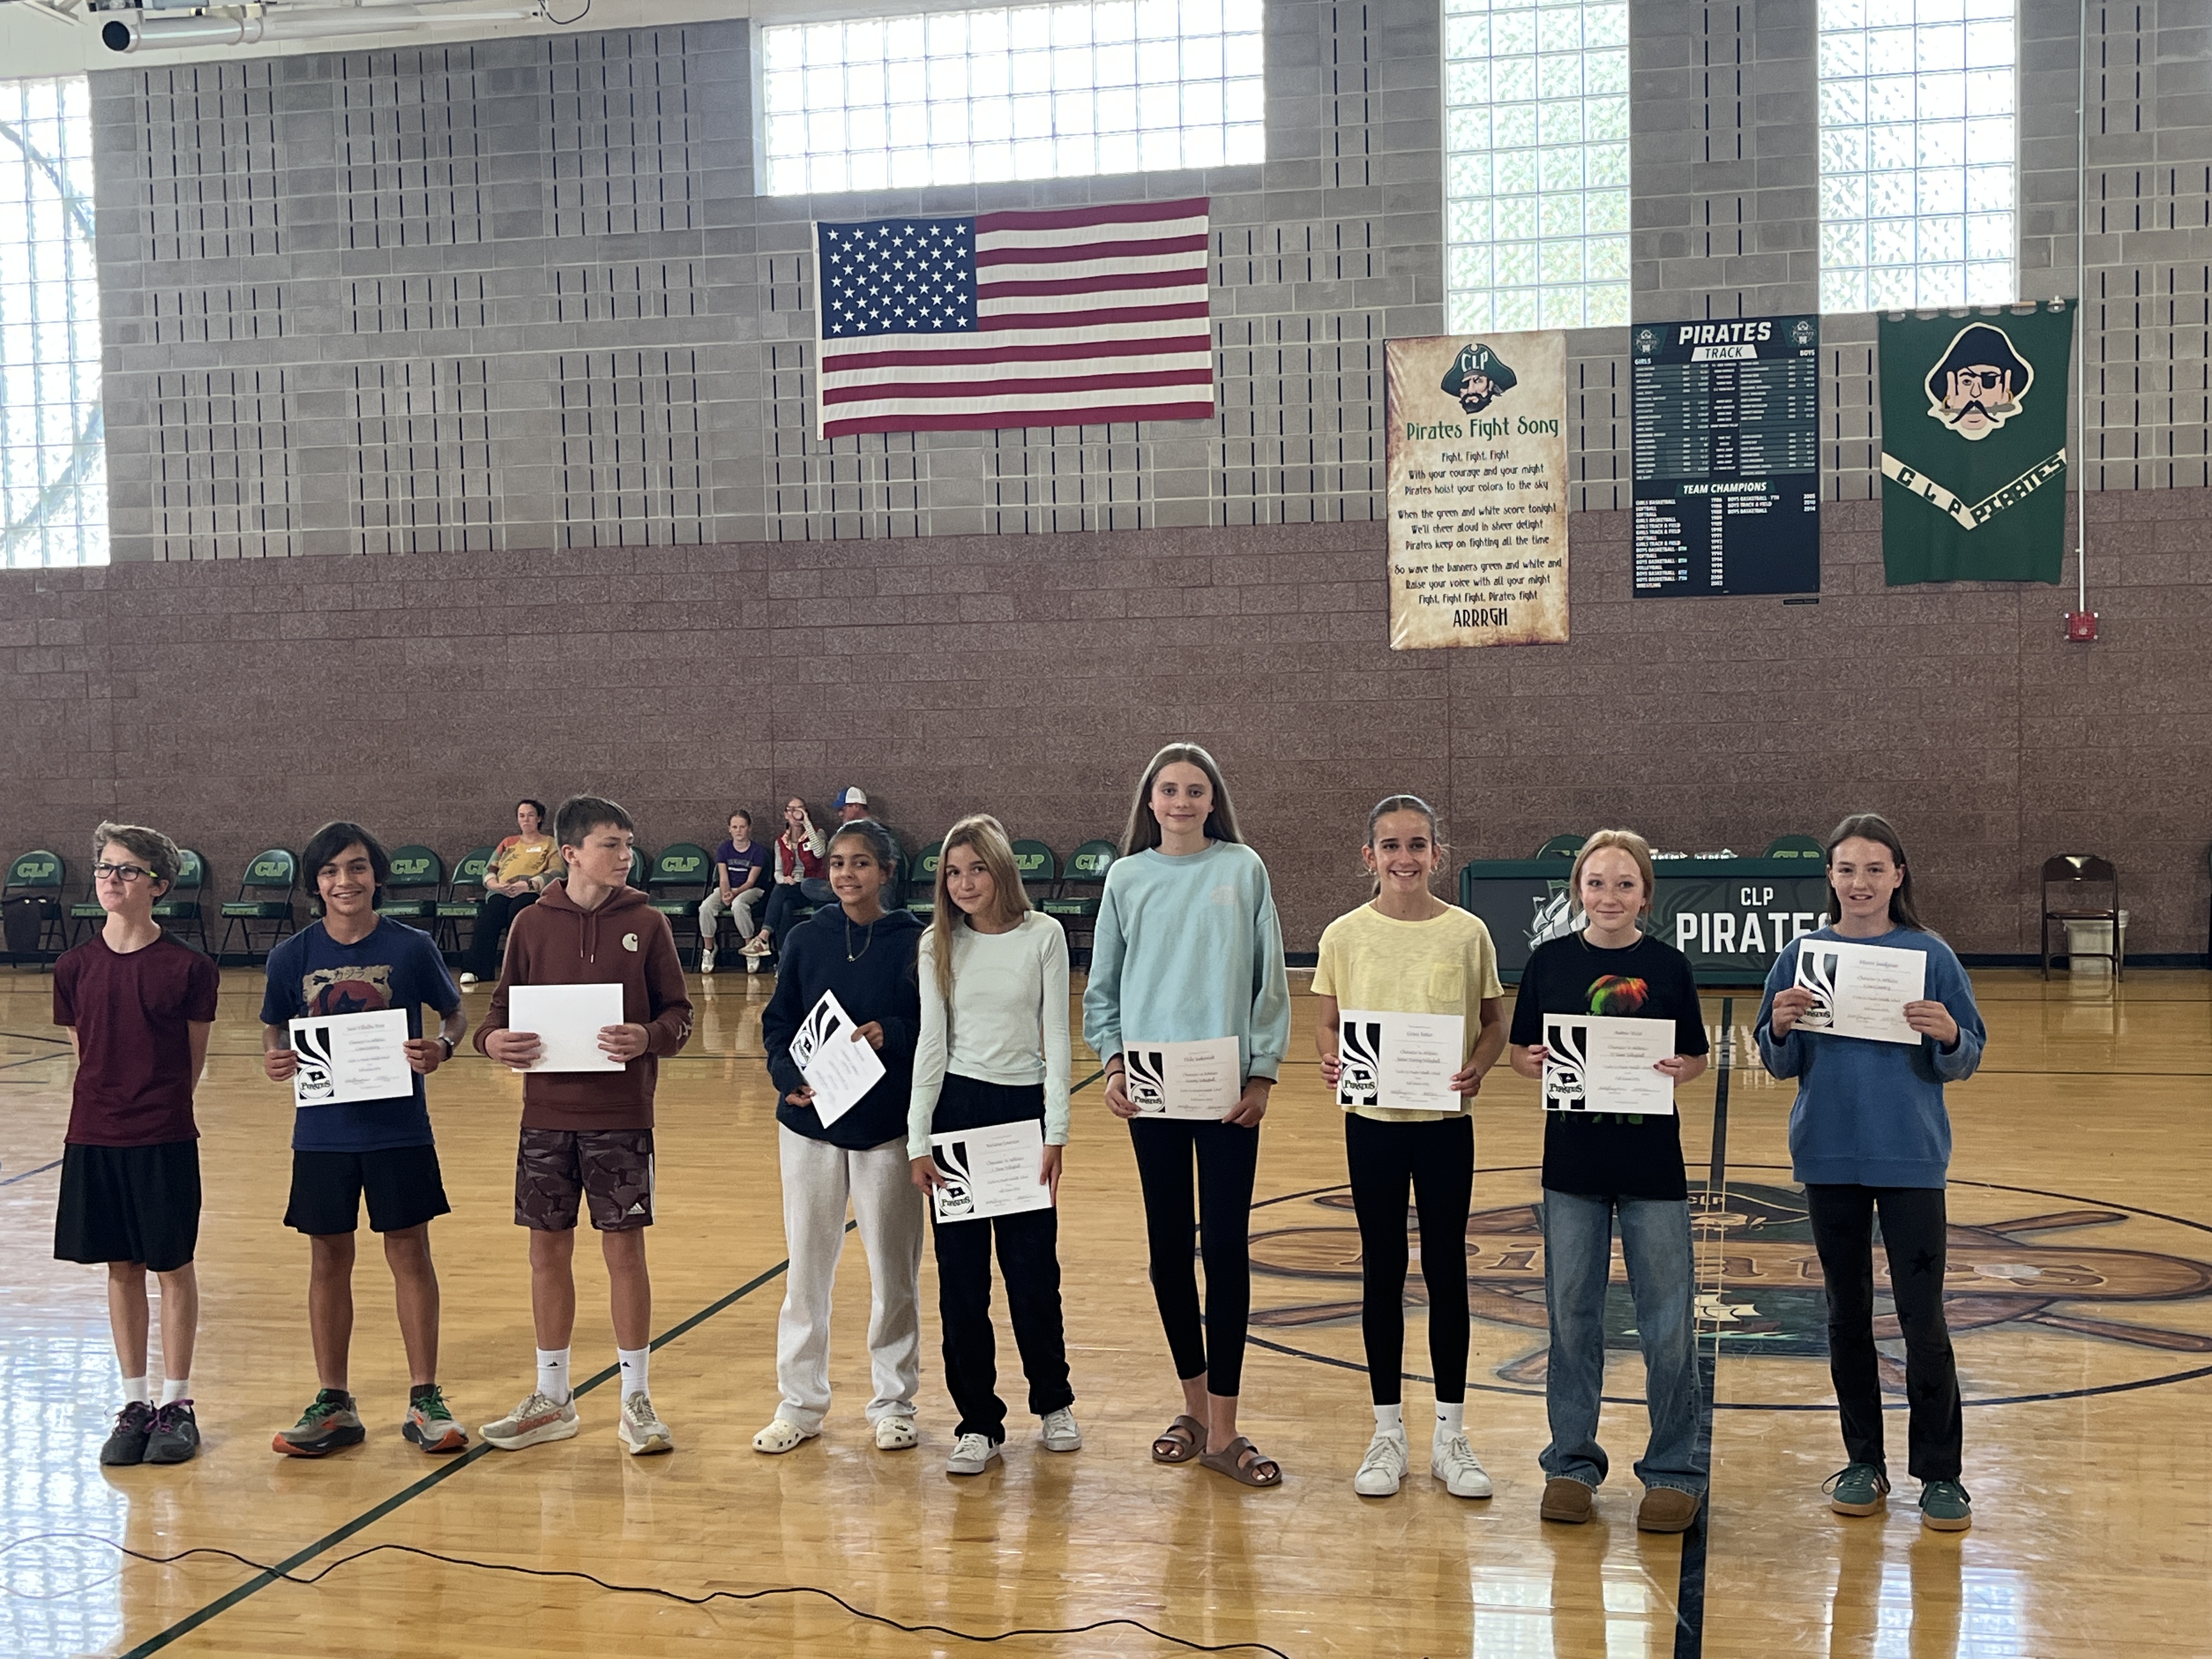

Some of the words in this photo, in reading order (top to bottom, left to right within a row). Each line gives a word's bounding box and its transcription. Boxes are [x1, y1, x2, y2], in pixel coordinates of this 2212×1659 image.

[1679, 322, 1771, 345] PIRATES
[1705, 347, 1742, 359] TRACK
[1462, 351, 1488, 372] CLP
[1407, 421, 1462, 441] Pirates
[1470, 417, 1509, 441] Fight
[1517, 416, 1558, 437] Song
[1408, 470, 1425, 479] With
[1429, 470, 1446, 481] your
[1449, 469, 1480, 478] courage
[1483, 466, 1497, 476] and
[1500, 467, 1519, 477] your
[1521, 464, 1544, 476] might
[1404, 485, 1432, 495] Pirates
[1435, 483, 1454, 494] hoist
[1457, 483, 1475, 494] your
[1478, 481, 1503, 491] colors
[1507, 481, 1515, 490] to
[1519, 478, 1531, 489] the
[1534, 479, 1548, 491] sky
[1683, 484, 1708, 494] TEAM
[1711, 482, 1767, 493] CHAMPIONS
[1897, 466, 1962, 515] CLP
[1398, 510, 1418, 519] When
[1421, 509, 1434, 518] the
[1436, 509, 1458, 520] green
[1462, 506, 1475, 516] and
[1479, 506, 1499, 516] white
[1503, 505, 1525, 514] score
[1528, 503, 1556, 515] tonight
[1411, 524, 1429, 534] We'll
[1433, 523, 1453, 533] cheer
[1457, 522, 1478, 532] aloud
[1482, 522, 1488, 531] in
[1492, 521, 1513, 531] sheer
[1516, 519, 1543, 531] delight
[1406, 540, 1432, 550] Pirates
[1435, 539, 1453, 550] keep
[1456, 540, 1466, 548] on
[1469, 537, 1499, 548] fighting
[1502, 536, 1511, 546] all
[1516, 535, 1528, 545] the
[1532, 535, 1549, 544] time
[1395, 564, 1405, 574] So
[1409, 565, 1428, 573] wave
[1432, 563, 1444, 572] the
[1447, 563, 1477, 572] banners
[1481, 562, 1502, 572] green
[1505, 560, 1519, 569] and
[1522, 558, 1544, 568] white
[1548, 557, 1561, 568] and
[1406, 579, 1425, 589] Raise
[1429, 580, 1446, 590] your
[1449, 578, 1469, 587] voice
[1473, 577, 1490, 586] with
[1494, 576, 1504, 585] all
[1507, 577, 1524, 587] your
[1528, 574, 1550, 586] might
[1488, 591, 1515, 601] Pirates
[1453, 608, 1508, 628] ARRRGH
[17, 862, 54, 878] CLP
[255, 861, 289, 877] CLP
[391, 859, 430, 875] CLP
[661, 857, 701, 872] CLP
[1018, 854, 1045, 870] LP
[1741, 887, 1773, 906] CLP
